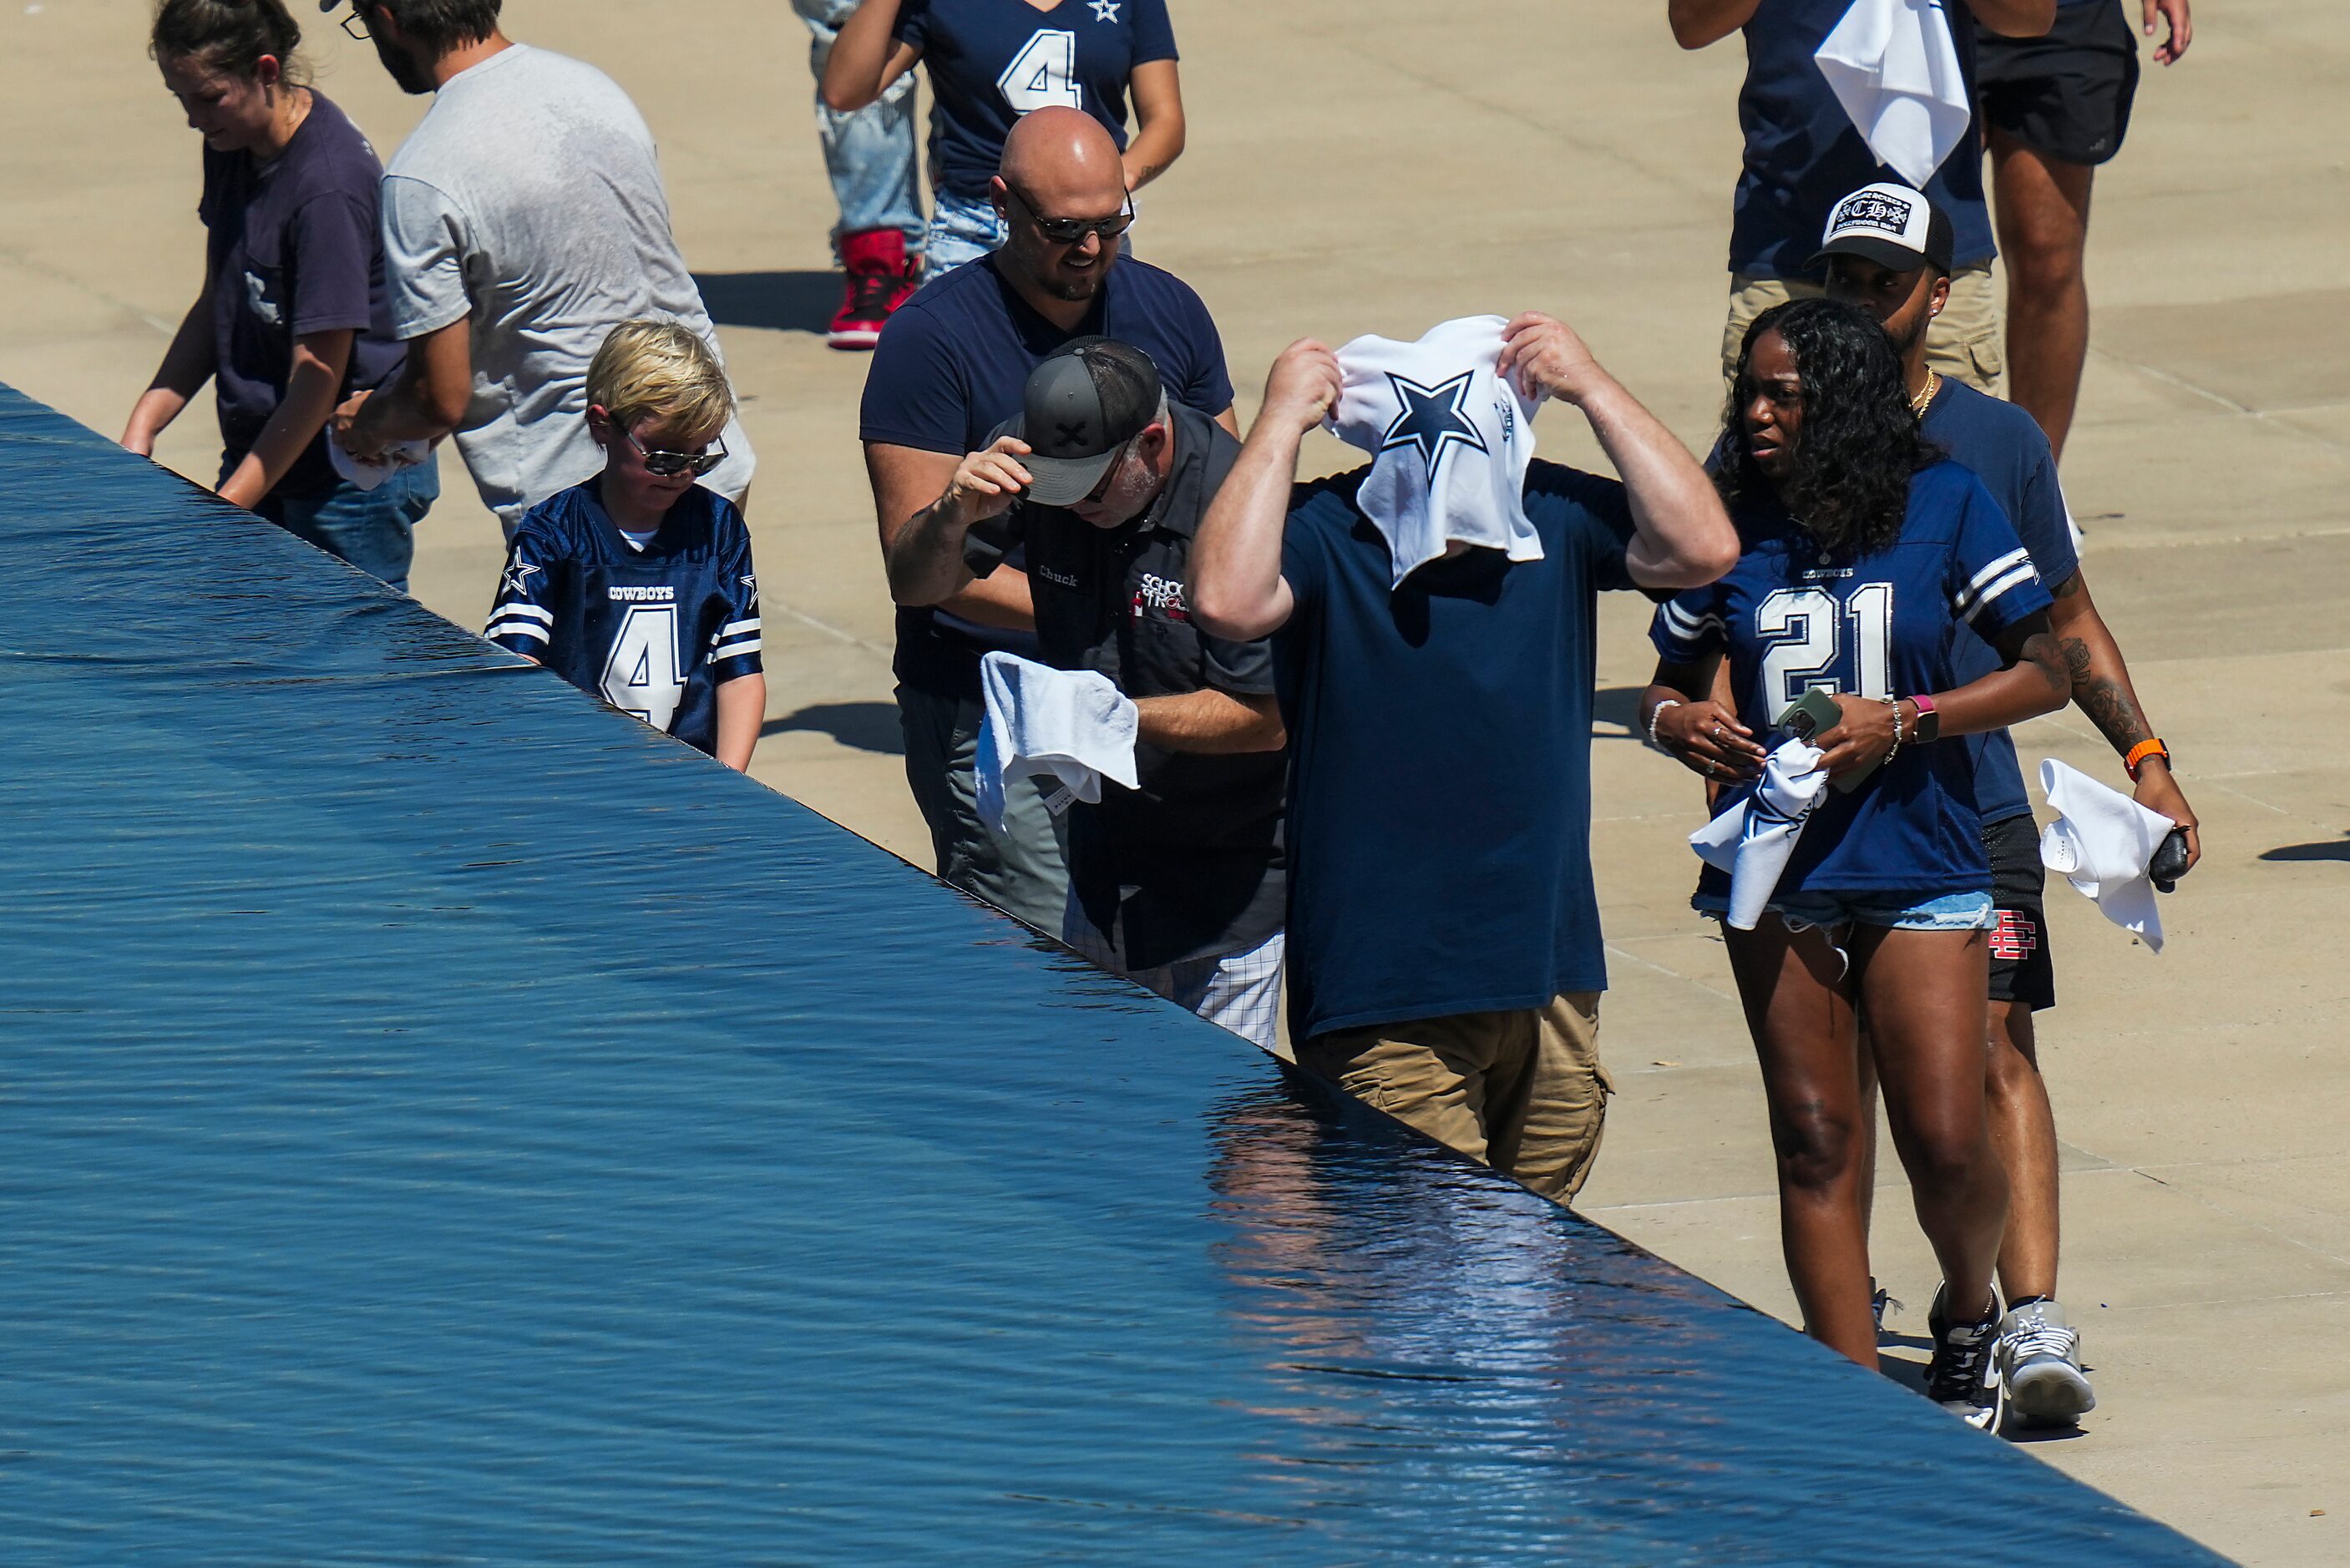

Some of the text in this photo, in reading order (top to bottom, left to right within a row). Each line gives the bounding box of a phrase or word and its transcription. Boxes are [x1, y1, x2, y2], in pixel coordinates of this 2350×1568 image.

[995, 28, 1081, 116] 4
[608, 586, 674, 600] COWBOYS
[1041, 564, 1078, 587] Chuck
[599, 603, 689, 733] 4
[1755, 582, 1894, 731] 21
